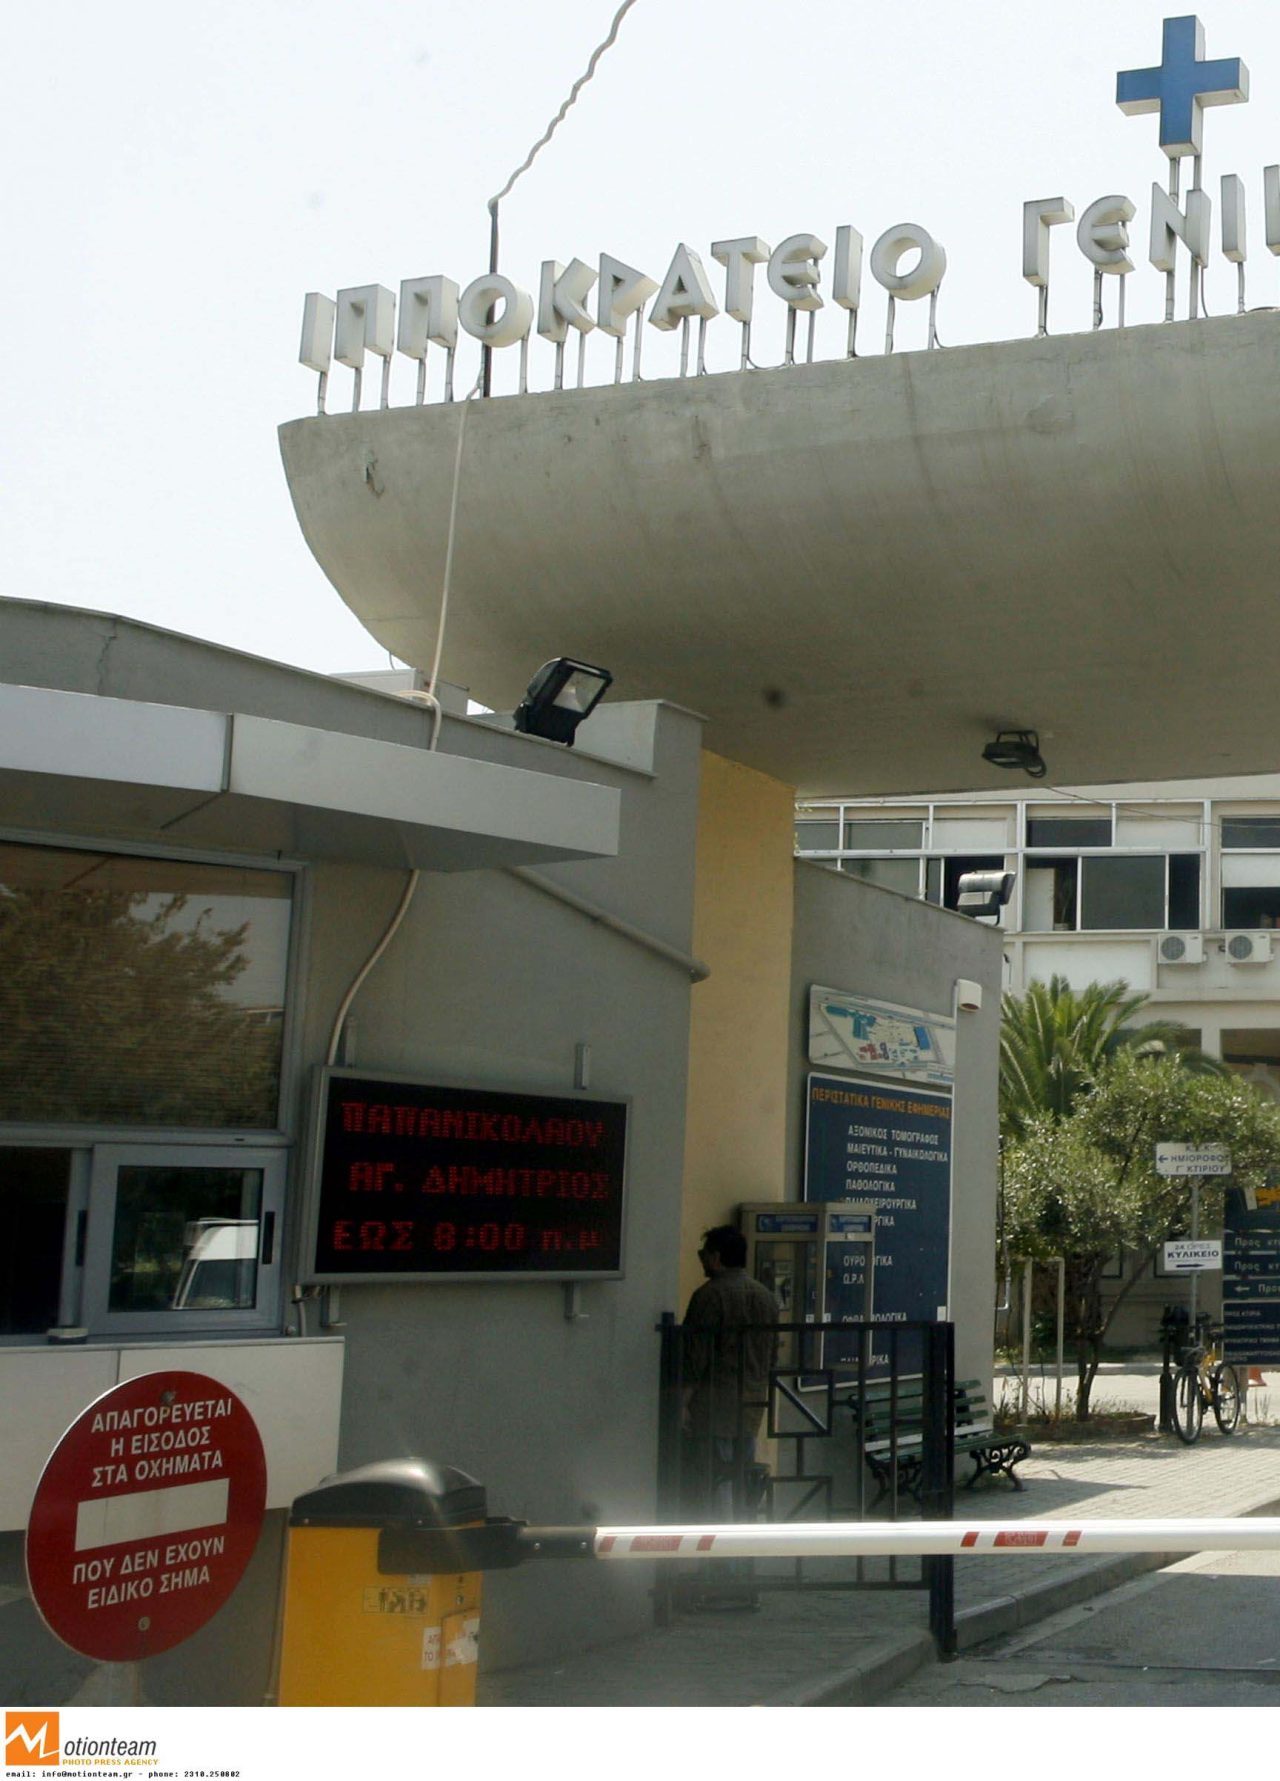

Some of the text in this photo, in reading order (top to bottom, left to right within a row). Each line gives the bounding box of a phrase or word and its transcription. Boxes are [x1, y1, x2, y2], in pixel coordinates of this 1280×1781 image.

[300, 223, 947, 372] ΙΠΠΟΚΡΑΤΕΙΟ
[342, 1103, 606, 1148] ΠΑΠΑΝΙΚΟΛΑΟΥ
[848, 1124, 939, 1145] ΑΞΟΝΙΚΟΣ ΤΟΜΟΓΡΑΦΟΣ
[846, 1160, 898, 1175] ΟΡΘΟΠΕΔΙΚΑ
[847, 1143, 888, 1157] ΜΑΙΕΥΤΙΚΑ
[894, 1147, 949, 1162] ΓΥΝΑΙΚΟΛΟΓΙΚΑ
[350, 1162, 610, 1200] ΑΓ. ΔΗΜΗΤΡΙΟΣ
[845, 1178, 896, 1192] ΠΑΘΟΛΟΓΙΚΑ
[333, 1221, 414, 1251] ΕΩΣ
[433, 1223, 526, 1251] 8:00
[1167, 1250, 1219, 1258] ΚΥΛΙΚΕΙΟ
[91, 1398, 233, 1433] ΑΠΑΓΟΡΕΥΕΤΑΙ
[110, 1425, 212, 1458] Η ΕΙΣΟΔΟΣ
[92, 1450, 223, 1488] ΣΤΑ ΟΧΗΜΑΤΑ
[73, 1536, 225, 1585] ΠΟΥ ΔΕΝ ΕΧΟΥΝ
[87, 1565, 210, 1610] ΕΙΔΙΚΟ ΣΗΜΑ
